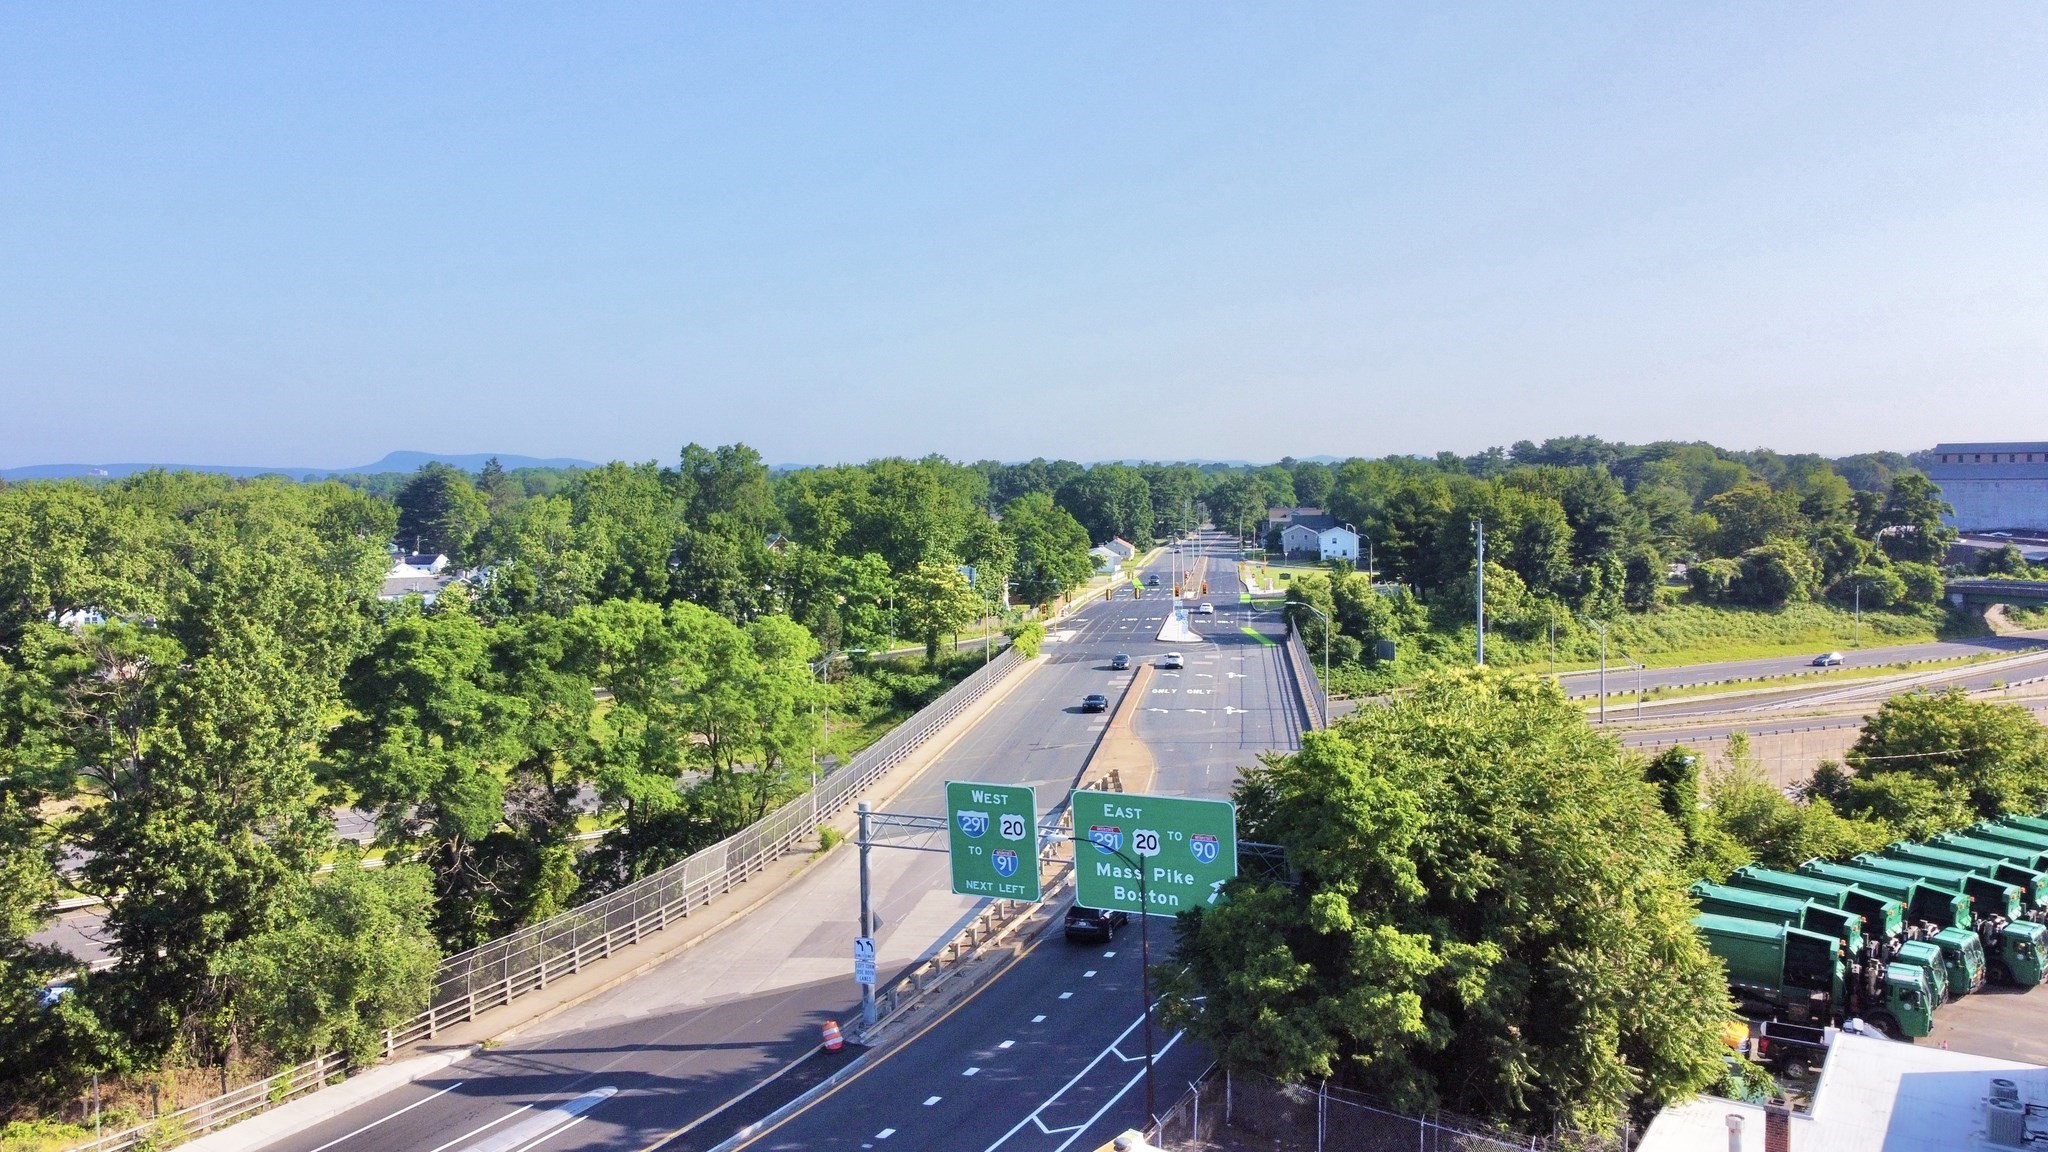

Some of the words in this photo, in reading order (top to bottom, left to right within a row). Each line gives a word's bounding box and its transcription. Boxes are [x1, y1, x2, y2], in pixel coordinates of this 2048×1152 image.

[971, 790, 1009, 805] WEST
[1103, 803, 1143, 819] EAST
[962, 816, 985, 832] 291
[1002, 820, 1024, 836] 20
[1094, 832, 1119, 850] 291
[1135, 833, 1157, 850] 20
[1167, 831, 1183, 841] TO
[1192, 841, 1216, 859] 90
[968, 845, 983, 856] TO
[997, 856, 1012, 872] 91
[1096, 862, 1145, 880] Mass
[1153, 867, 1194, 885] Pike
[966, 879, 994, 891] NEXT
[999, 883, 1025, 895] LEFT
